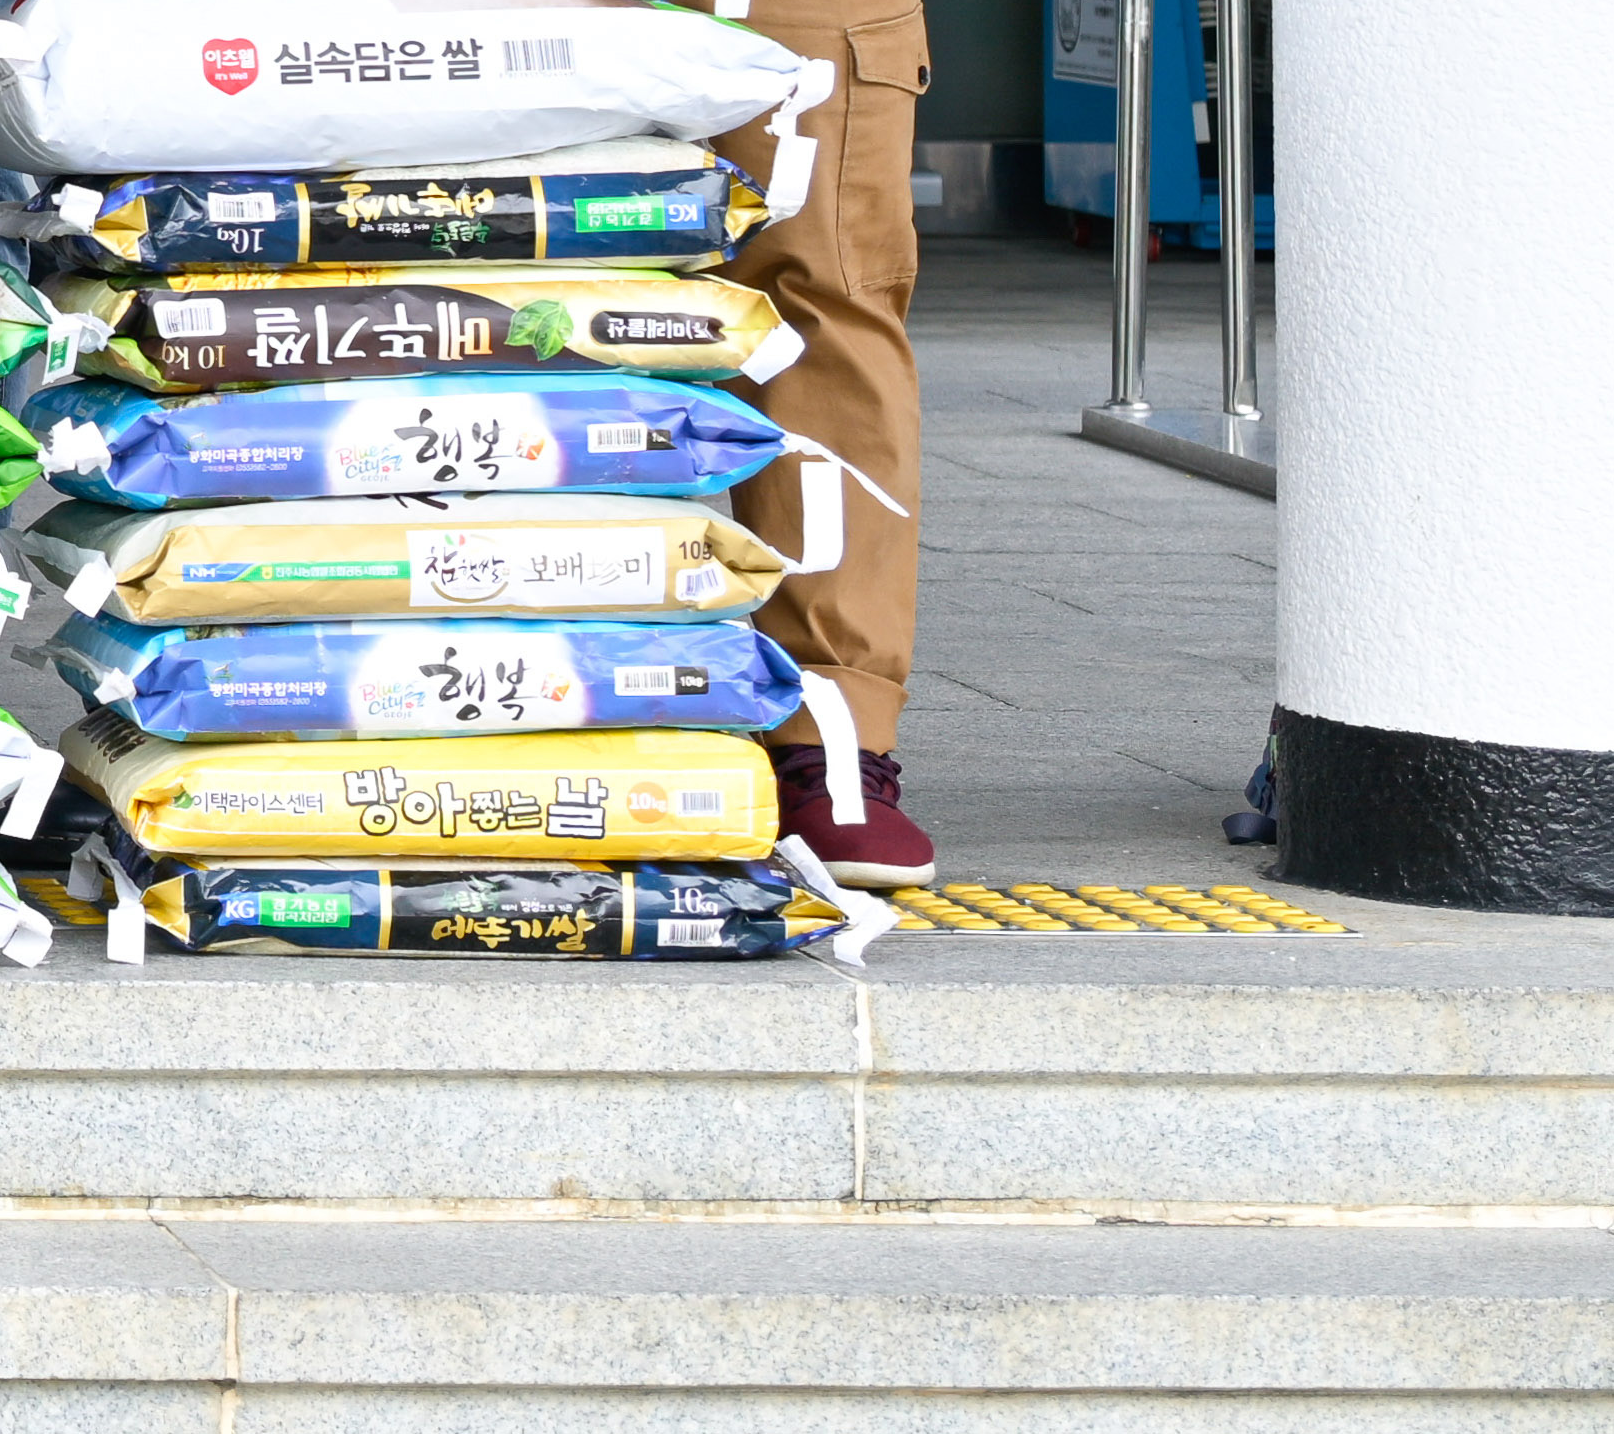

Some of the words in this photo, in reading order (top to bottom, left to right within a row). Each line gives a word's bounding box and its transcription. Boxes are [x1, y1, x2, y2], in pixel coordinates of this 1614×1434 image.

[204, 47, 256, 69] 이츠웰
[274, 38, 436, 84] 실속담은
[440, 37, 483, 82] 쌀
[250, 301, 492, 369] 메뚜기쌀
[394, 408, 512, 482] 행복
[419, 645, 531, 723] 행복
[190, 787, 325, 816] 이택라이스센터
[225, 897, 257, 923] KG
